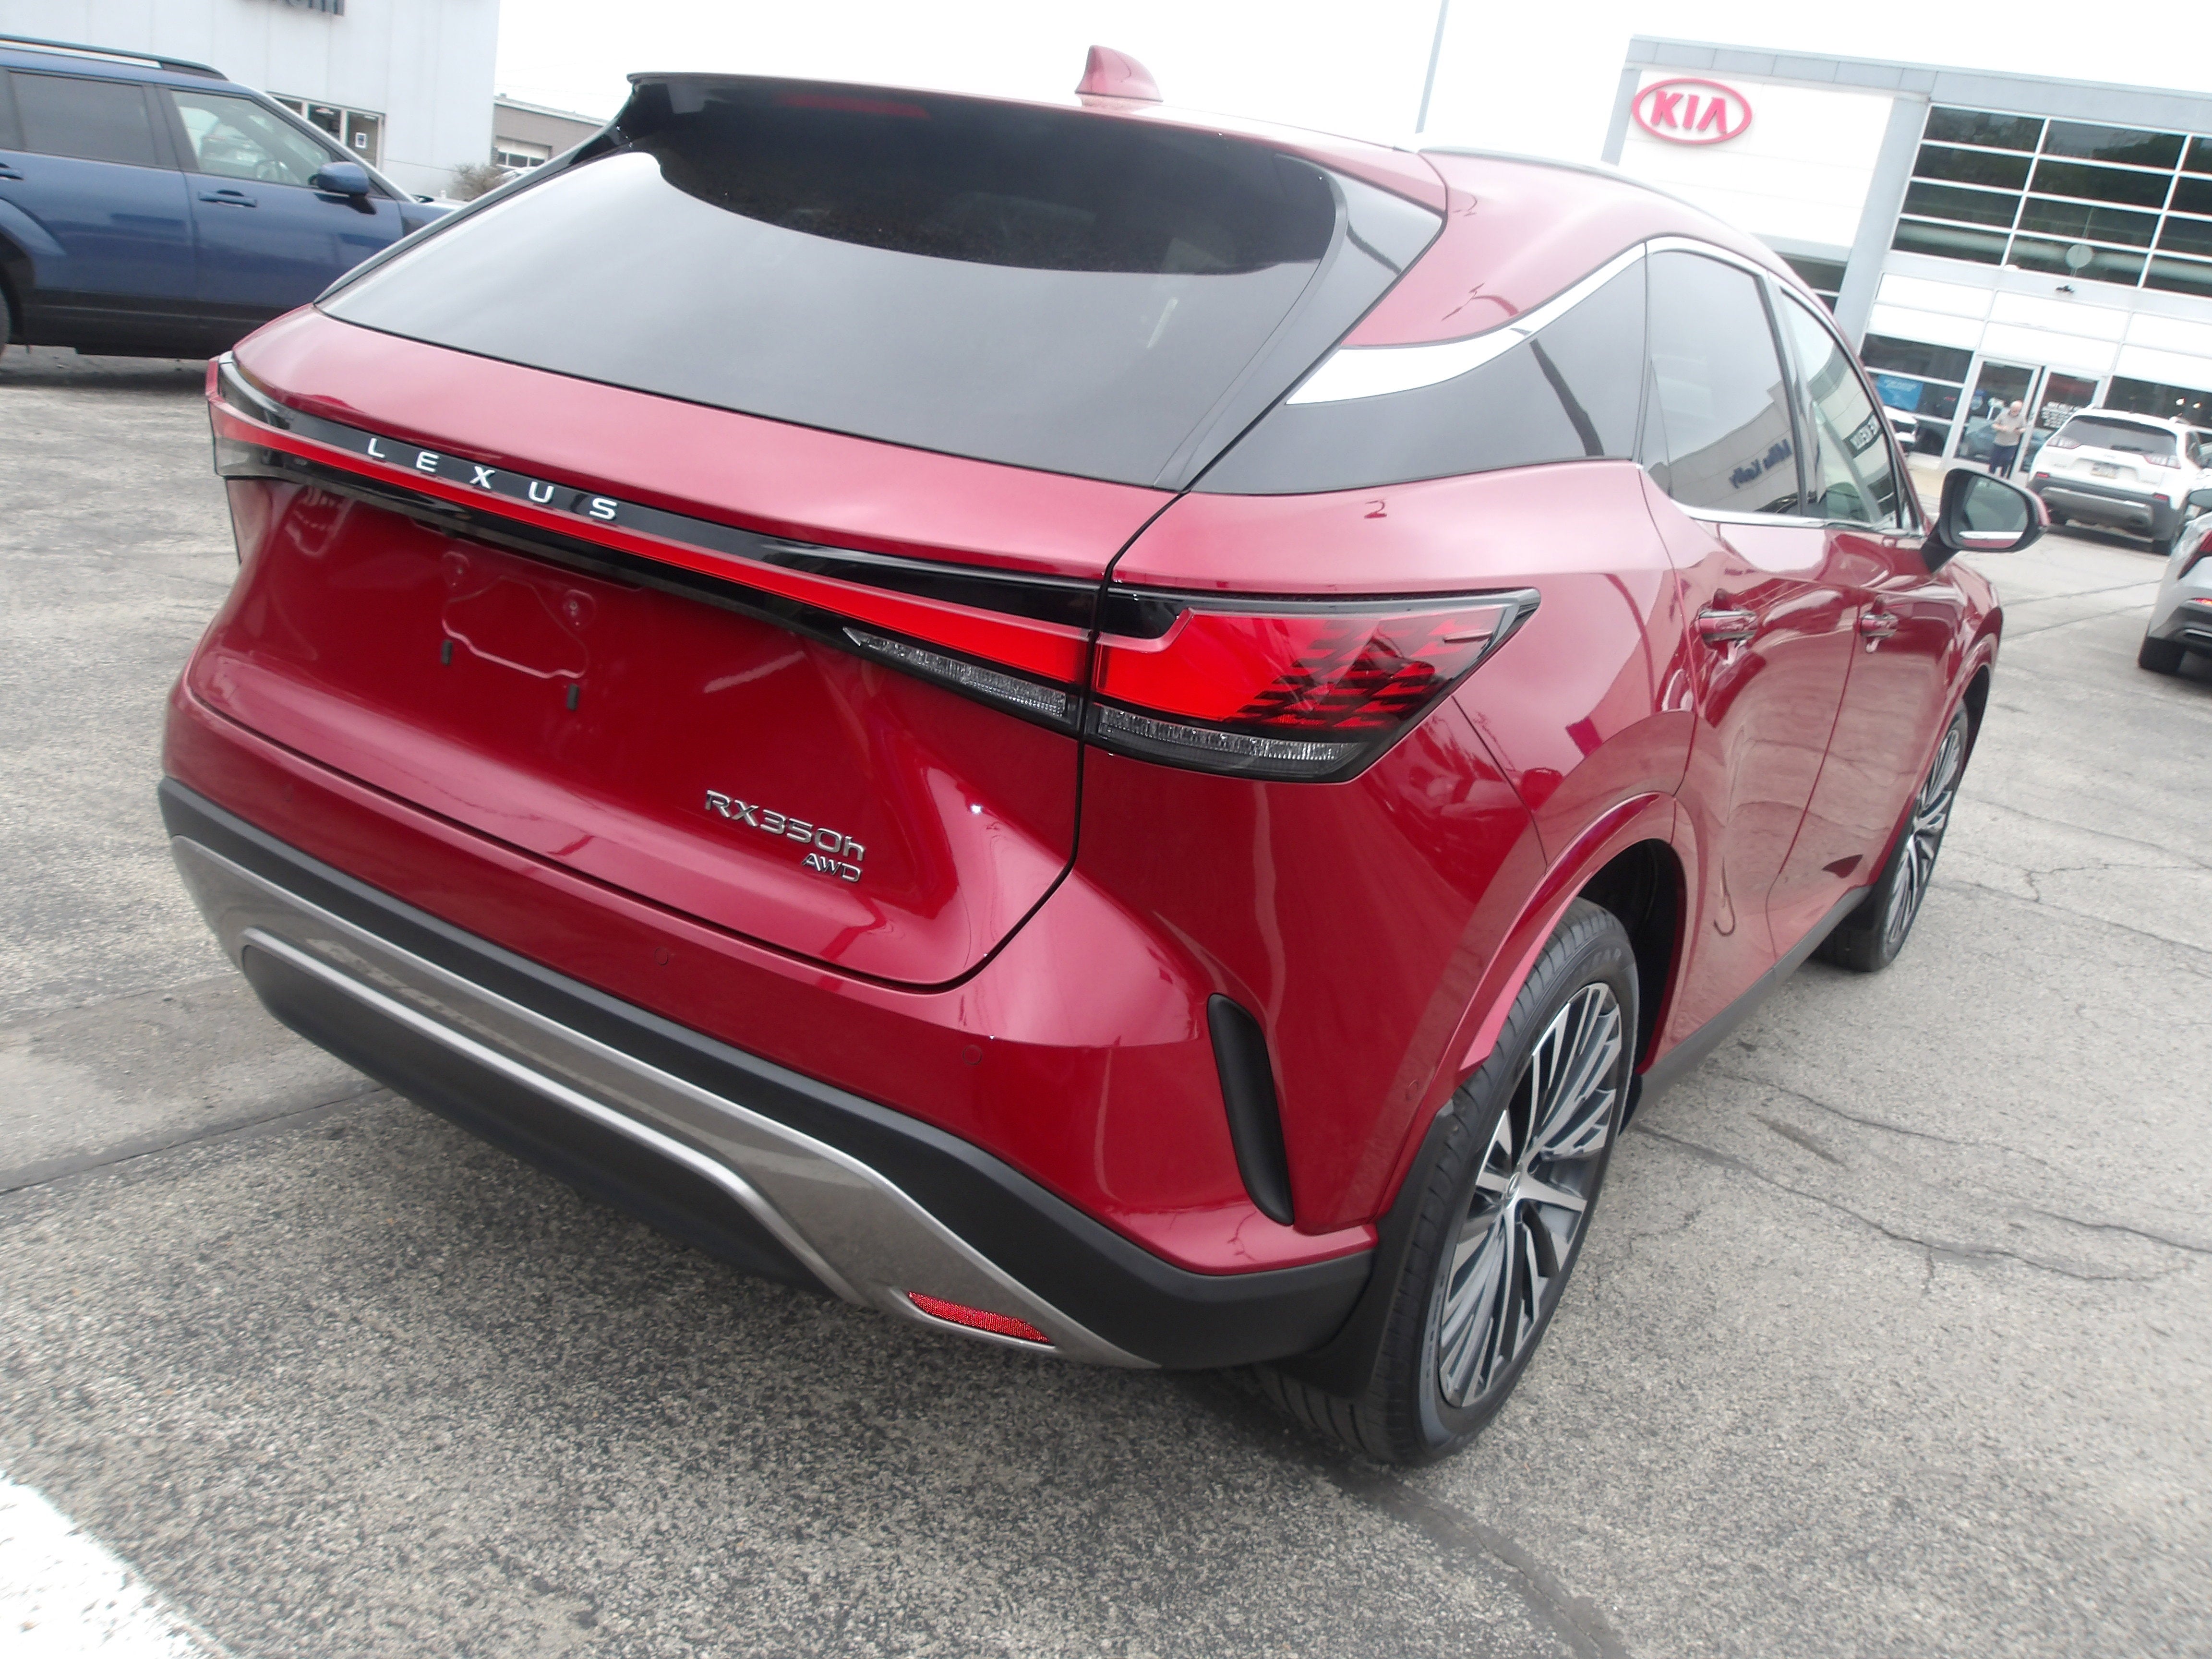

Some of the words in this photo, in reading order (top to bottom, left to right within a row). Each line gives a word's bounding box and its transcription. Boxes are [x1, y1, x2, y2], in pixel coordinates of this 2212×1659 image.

[1650, 90, 1728, 135] KIA
[367, 437, 618, 521] LEXUS
[705, 789, 865, 861] RX350h
[801, 853, 863, 883] AWD
